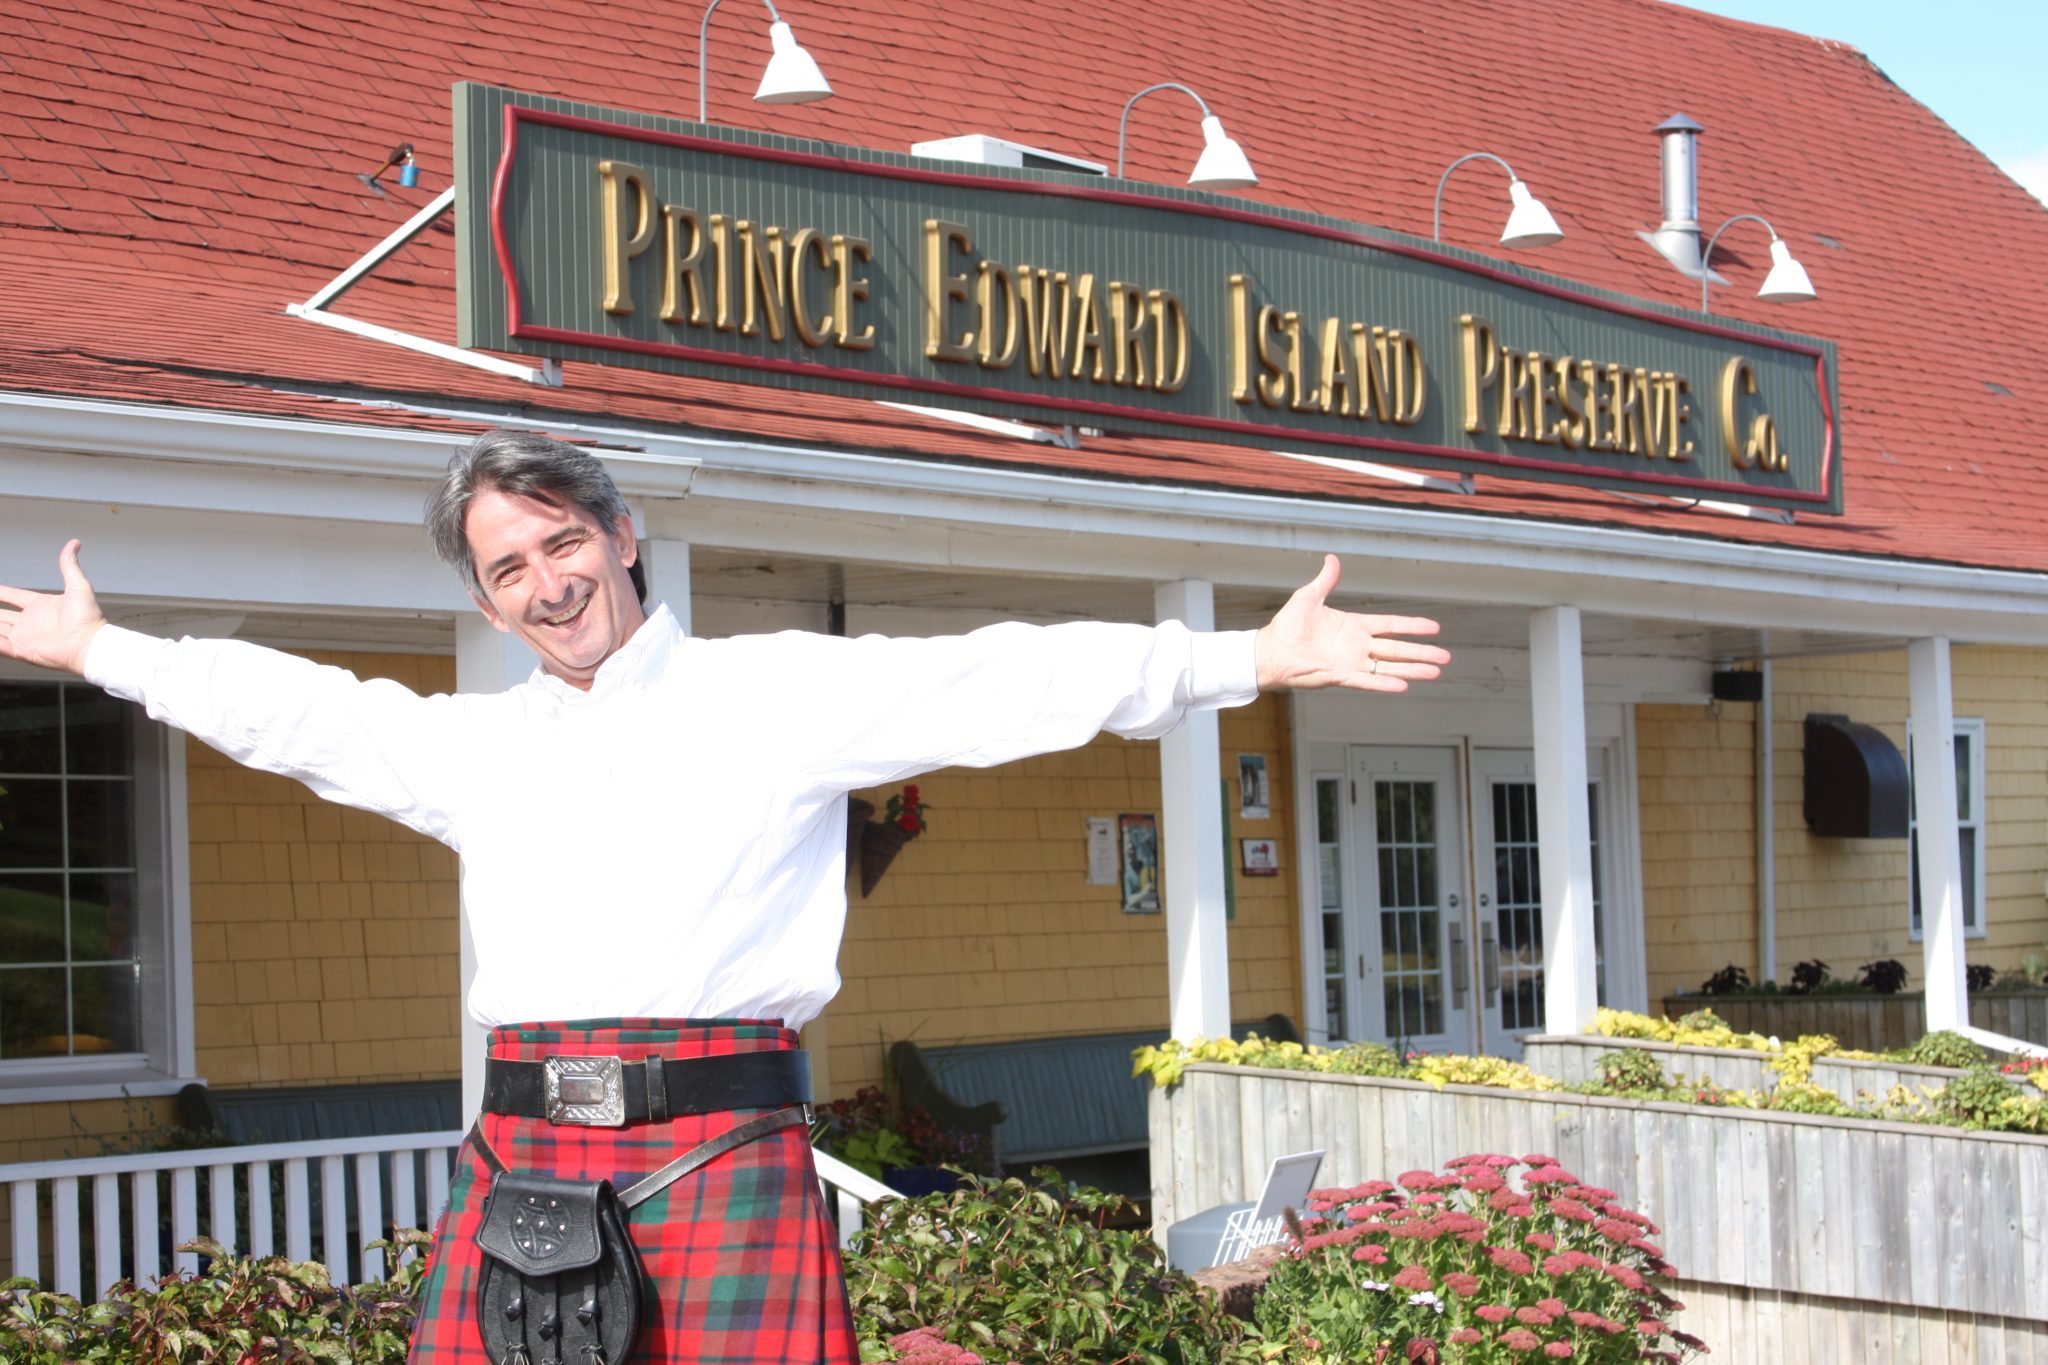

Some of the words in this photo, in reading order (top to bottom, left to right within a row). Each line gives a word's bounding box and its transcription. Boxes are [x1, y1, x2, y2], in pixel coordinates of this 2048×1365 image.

[600, 161, 875, 348] PRINCE
[926, 219, 1190, 392] EDWARD
[1230, 274, 1426, 423] ISLAND
[1461, 314, 1693, 459] PRESERVE
